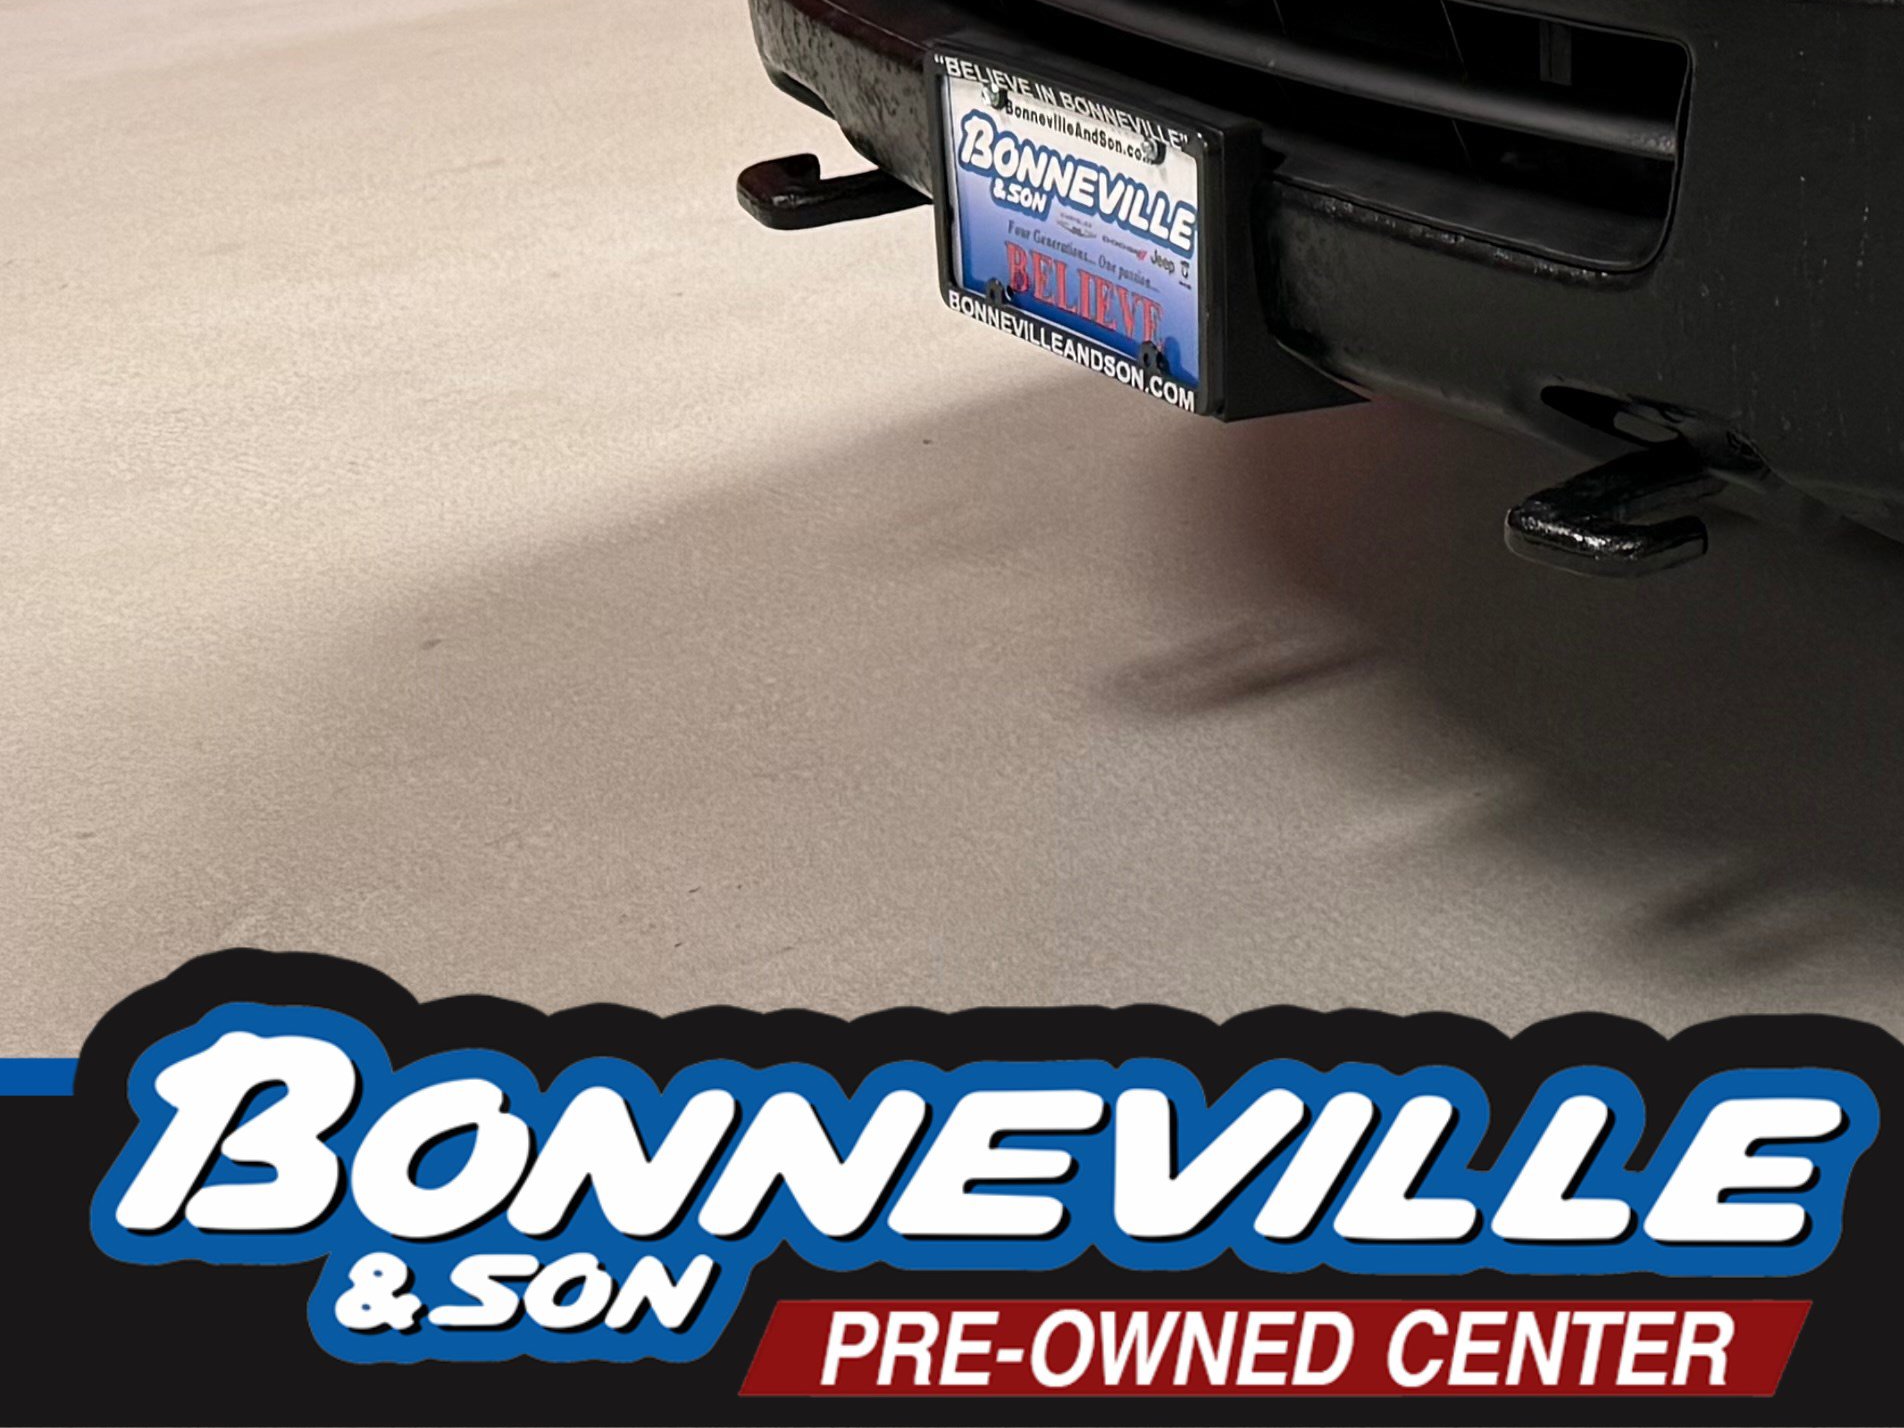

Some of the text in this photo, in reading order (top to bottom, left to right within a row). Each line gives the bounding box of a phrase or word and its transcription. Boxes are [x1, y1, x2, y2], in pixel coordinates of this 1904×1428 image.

[1035, 82, 1058, 106] IN
[1005, 99, 1156, 161] BonnevilleAndSon.co
[962, 114, 1196, 250] BONNEVILLE
[1008, 219, 1031, 239] Four
[1149, 248, 1176, 275] Jeep
[1005, 241, 1166, 352] BELIEVE
[947, 289, 1196, 412] BONNEVILLEANDSON.COM
